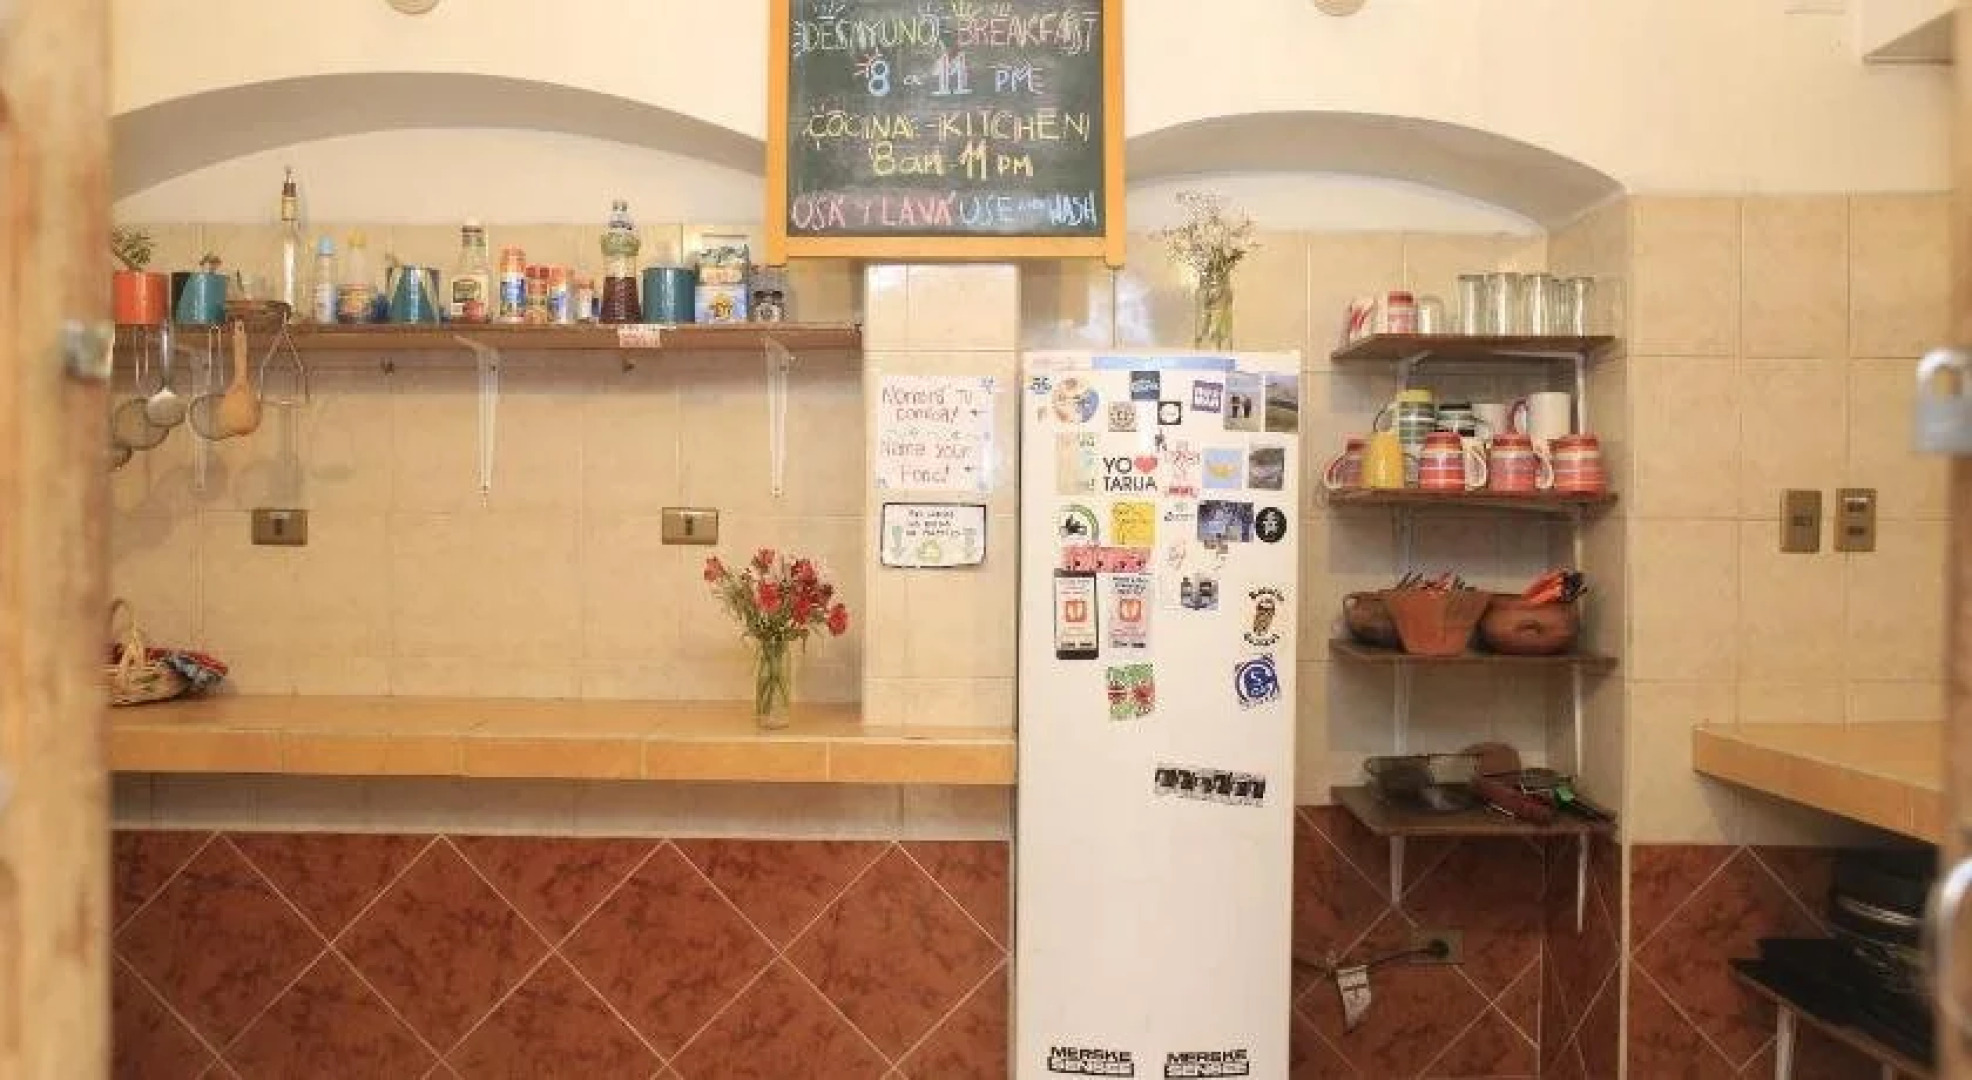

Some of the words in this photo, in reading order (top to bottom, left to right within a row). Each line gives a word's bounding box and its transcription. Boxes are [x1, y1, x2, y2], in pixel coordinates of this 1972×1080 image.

[957, 14, 1096, 52] BREAKFAST
[868, 58, 891, 97] 8
[932, 51, 973, 95] 11
[938, 111, 1091, 142] KITCHEN
[958, 139, 987, 181] 11
[959, 195, 1015, 227] USE
[1049, 190, 1098, 227] WASH
[1102, 456, 1134, 475] YO
[1102, 477, 1158, 492] TARIJA
